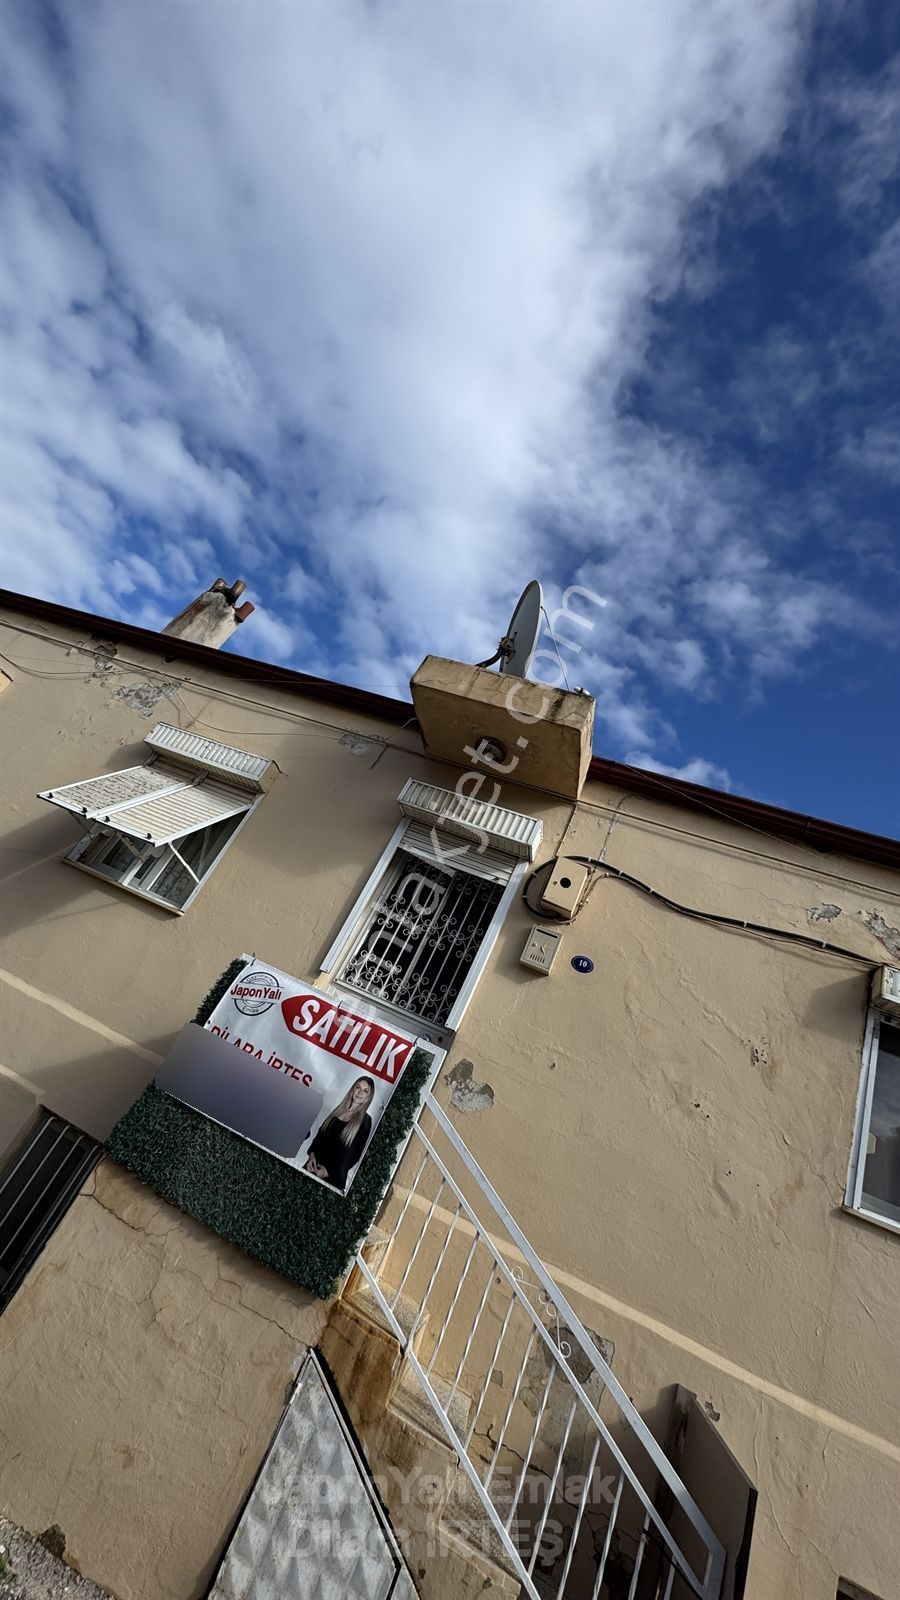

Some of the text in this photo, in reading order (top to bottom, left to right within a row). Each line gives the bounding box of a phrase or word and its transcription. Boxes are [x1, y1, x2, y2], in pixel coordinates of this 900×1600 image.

[579, 959, 588, 968] 10
[230, 984, 282, 1000] JaponYalı
[292, 999, 408, 1077] SATILIK
